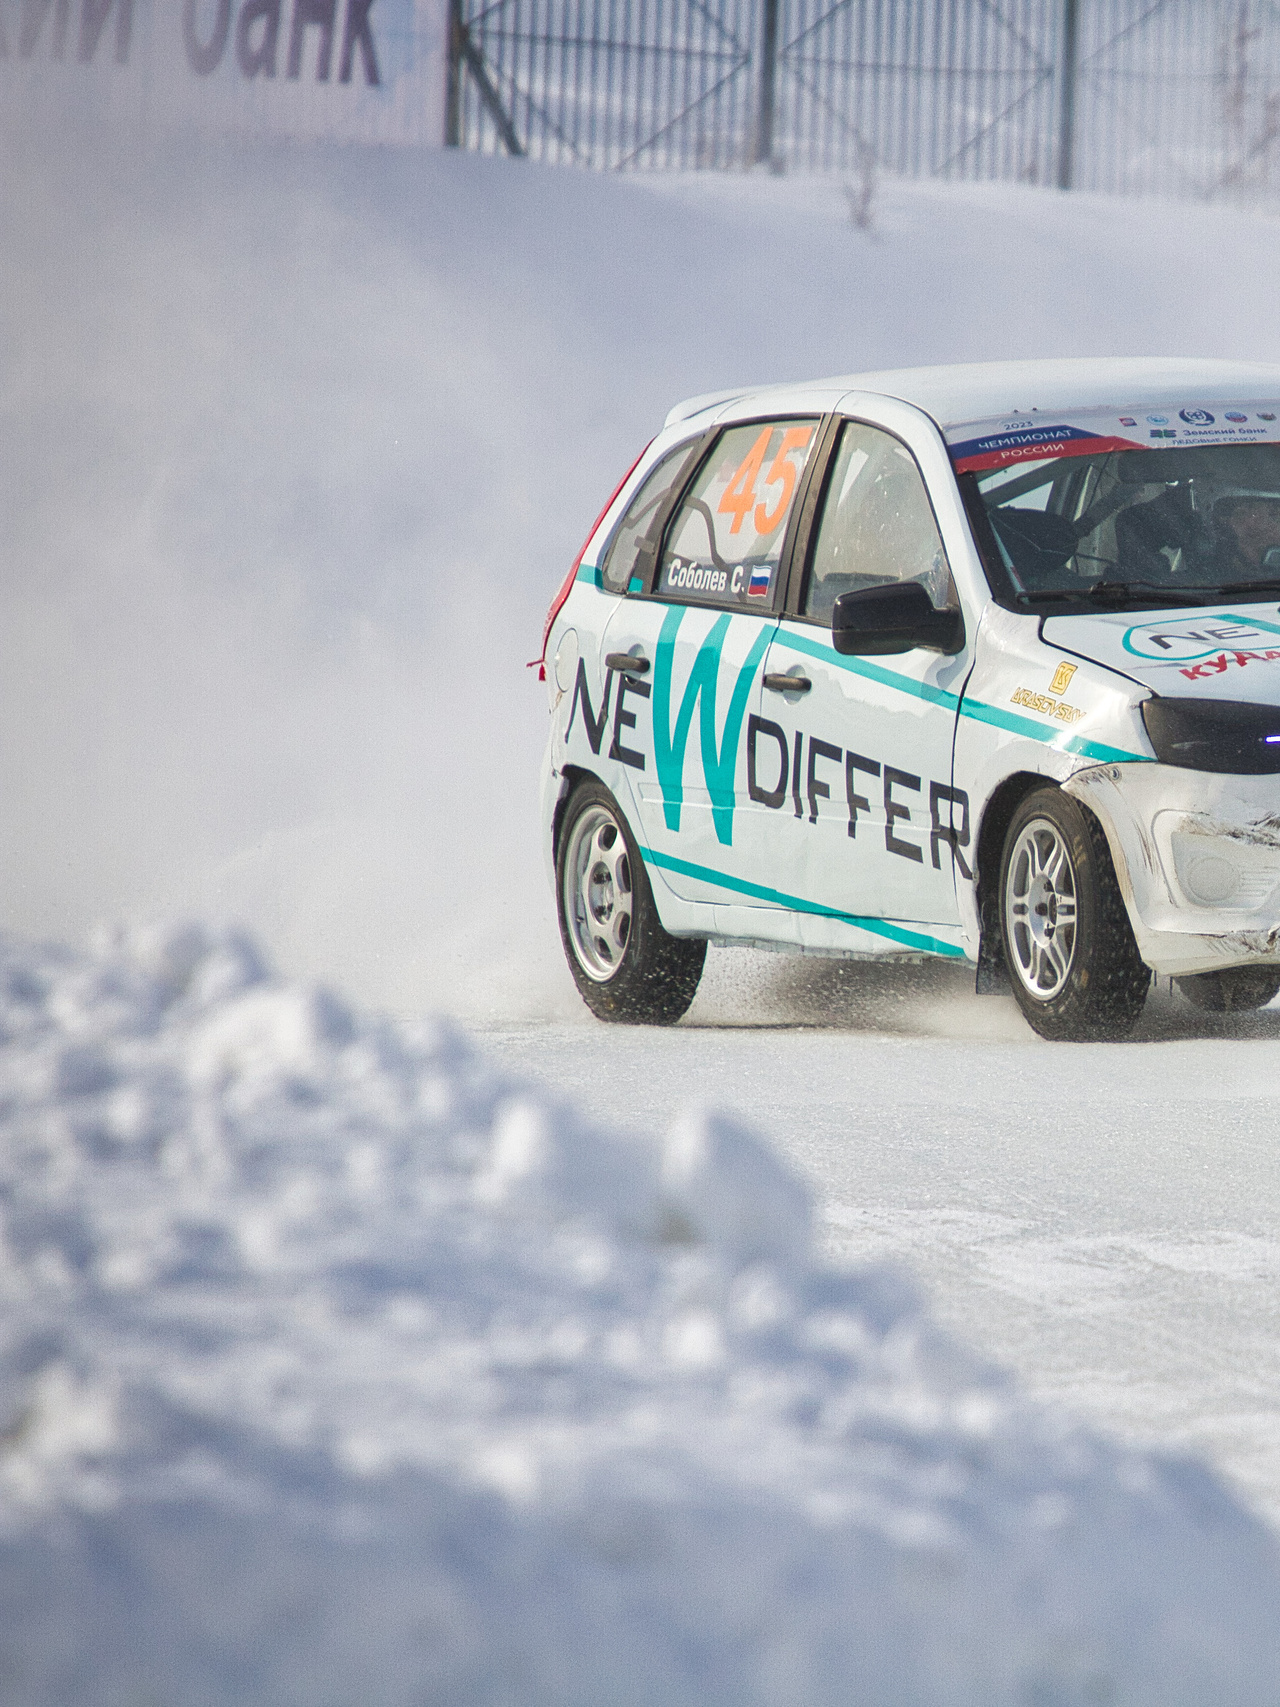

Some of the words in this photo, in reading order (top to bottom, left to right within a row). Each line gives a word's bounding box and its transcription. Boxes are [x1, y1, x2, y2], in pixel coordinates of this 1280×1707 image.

[1004, 421, 1034, 431] 2023
[1183, 428, 1236, 436] Земский
[1238, 427, 1268, 435] банк
[978, 429, 1073, 450] ЧЕМПИОНАТ
[1001, 443, 1065, 459] РОССИИ
[717, 426, 814, 536] 45
[667, 558, 728, 592] Соболев
[730, 565, 746, 593] С.
[1009, 686, 1087, 725] KRASOVSKY
